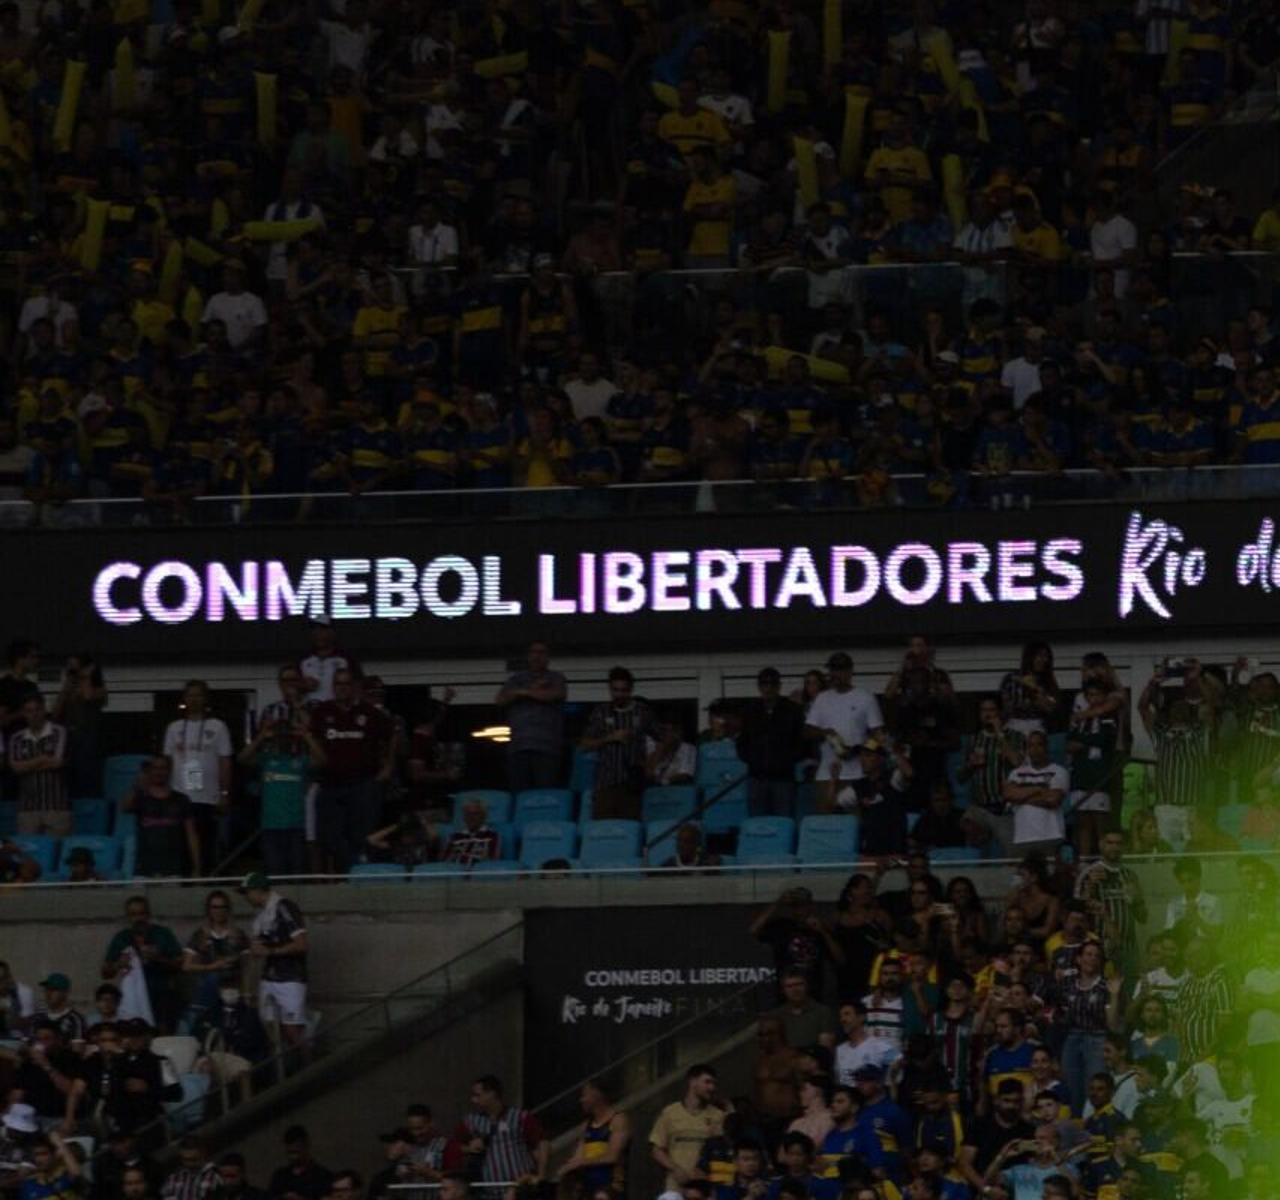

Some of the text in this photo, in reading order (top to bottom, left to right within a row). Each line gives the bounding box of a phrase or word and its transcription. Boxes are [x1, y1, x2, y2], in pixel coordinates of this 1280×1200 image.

[92, 554, 522, 625] CONMEBOL
[537, 536, 1086, 616] LIBERTADORES
[1116, 509, 1208, 620] Rio
[584, 968, 685, 987] CONMEBOL
